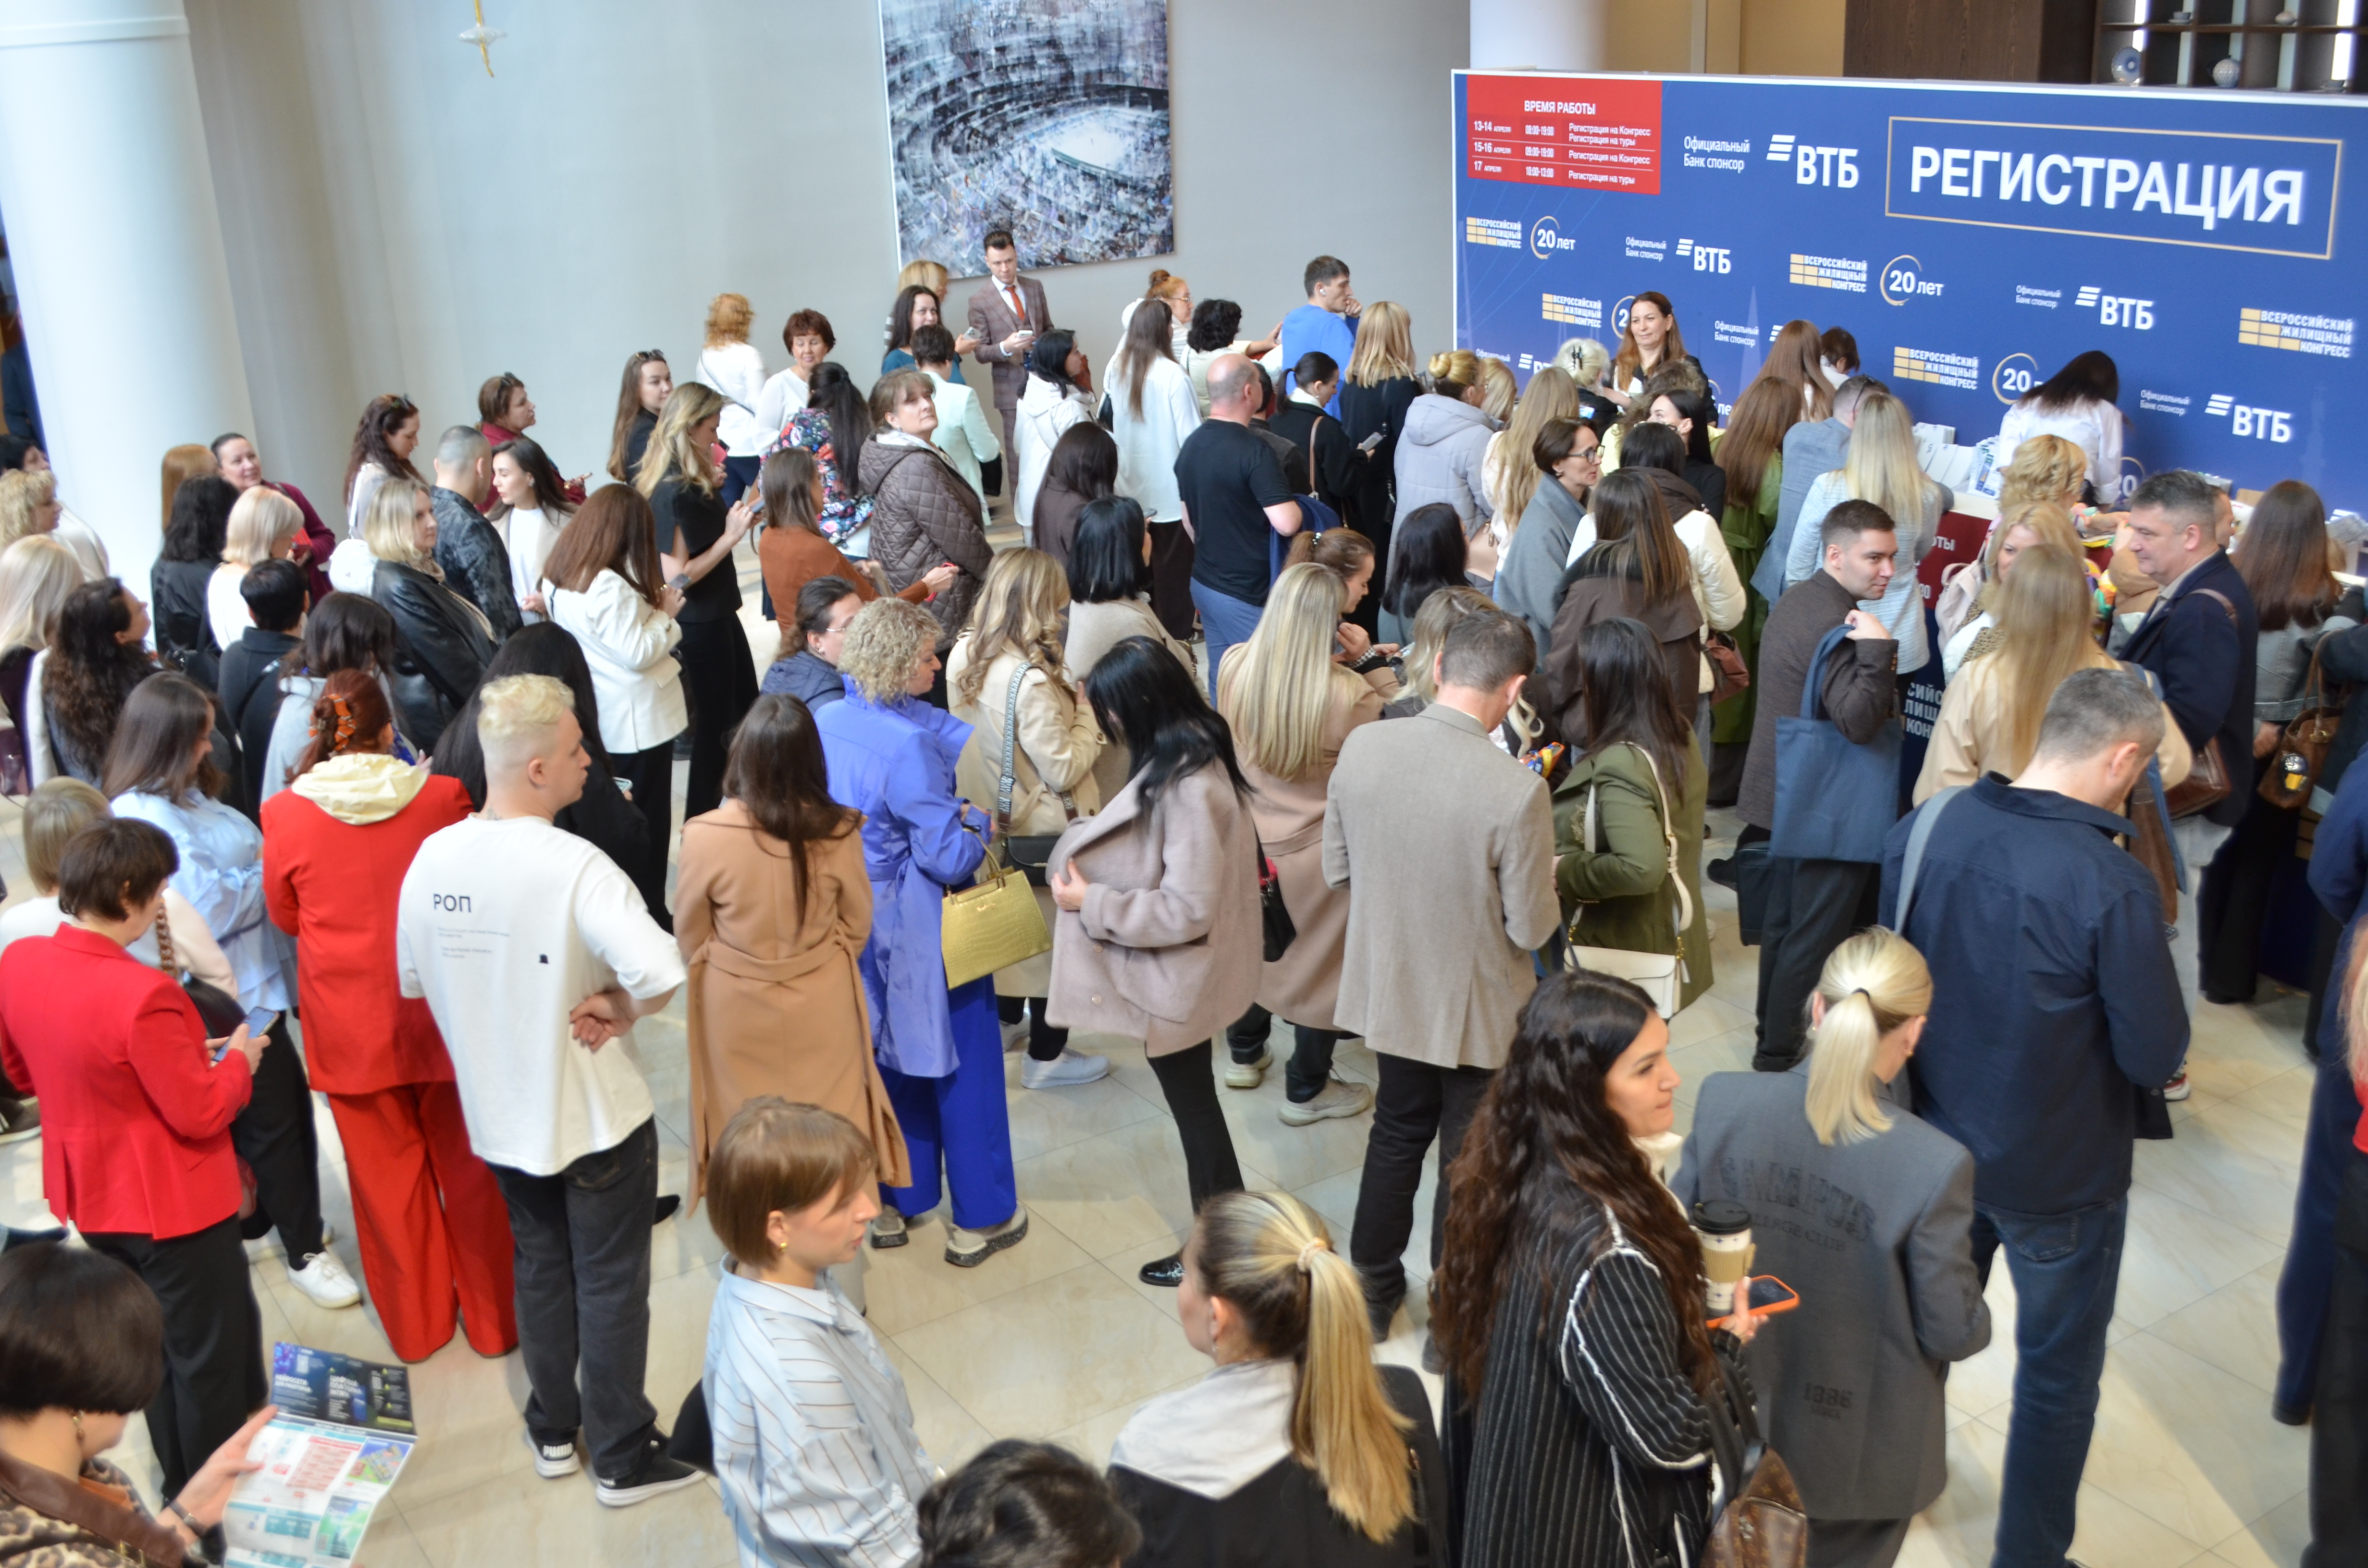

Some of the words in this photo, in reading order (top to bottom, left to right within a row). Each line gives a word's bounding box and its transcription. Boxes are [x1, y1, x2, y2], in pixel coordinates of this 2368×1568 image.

[1524, 100, 1555, 113] ВРЕМЯ
[1557, 102, 1596, 115] РАБОТЫ
[1474, 121, 1492, 132] 13-14
[1569, 123, 1609, 135] Регистрация
[1619, 125, 1651, 137] Конгресс
[1474, 142, 1492, 153] 15-16
[1569, 133, 1609, 145] Регистрация
[1619, 138, 1636, 147] туры
[1684, 135, 1750, 153] Официальный
[1569, 150, 1609, 162] Регистрация
[1619, 153, 1651, 165] Конгресс
[1684, 153, 1705, 167] Банк
[1707, 157, 1745, 173] спонсор
[1474, 161, 1482, 171] 17
[1797, 145, 1859, 188] ВТБ
[1569, 170, 1609, 183] Регистрация
[1619, 177, 1635, 185] туры
[1911, 146, 2304, 230] РЕГИСТРАЦИЯ
[1476, 218, 1522, 231] ВСЕРОССИЙСКИЙ
[1487, 228, 1522, 240] ЖИЛИЩНЫЙ
[1537, 229, 1555, 248] 20
[1556, 238, 1576, 250] лет
[1496, 238, 1521, 248] КОНГРЕСС
[1626, 236, 1666, 249] Официальный
[1626, 247, 1639, 257] Банк
[1640, 251, 1663, 262] спонсор
[1694, 245, 1731, 274] ВТБ
[1804, 255, 1867, 271] ВСЕРОССИЙСКИЙ
[1818, 268, 1867, 282] ЖИЛИЩНЫЙ
[1889, 270, 1915, 293] 20
[1916, 281, 1944, 296] лет
[1832, 279, 1866, 293] КОНГРЕСС
[2016, 285, 2061, 298] Официальный
[1553, 294, 1602, 310] ВСЕРОССИЙСКИЙ
[2016, 295, 2030, 305] Банк
[2031, 298, 2057, 309] спонсор
[1564, 306, 1602, 318] ЖИЛИЩНЫЙ
[1618, 308, 1630, 327] 2
[2100, 295, 2154, 330] ВТБ
[1575, 317, 1602, 328] КОНГРЕСС
[1714, 320, 1760, 335] Официальный
[2261, 310, 2354, 332] ВСЕРОССИЙСКИЙ
[1714, 331, 1729, 342] Банк
[1730, 335, 1755, 348] спонсор
[2281, 325, 2352, 345] ЖИЛИЩНЫЙ
[2300, 340, 2350, 358] КОНГРЕСС
[1910, 349, 1978, 368] ВСЕРОССИЙСКИЙ
[1924, 361, 1978, 379] ЖИЛИЩНЫЙ
[1939, 375, 1977, 390] КОНГРЕСС
[2002, 368, 2031, 392] 20
[2141, 389, 2190, 405] Официальный
[1717, 403, 1733, 415] ле
[2140, 400, 2156, 410] Банк
[2157, 404, 2185, 416] спонсор
[2232, 404, 2291, 443] ВТБ
[2119, 475, 2137, 497] 0
[433, 893, 471, 913] РОП
[1751, 1212, 1802, 1238] LLEGE
